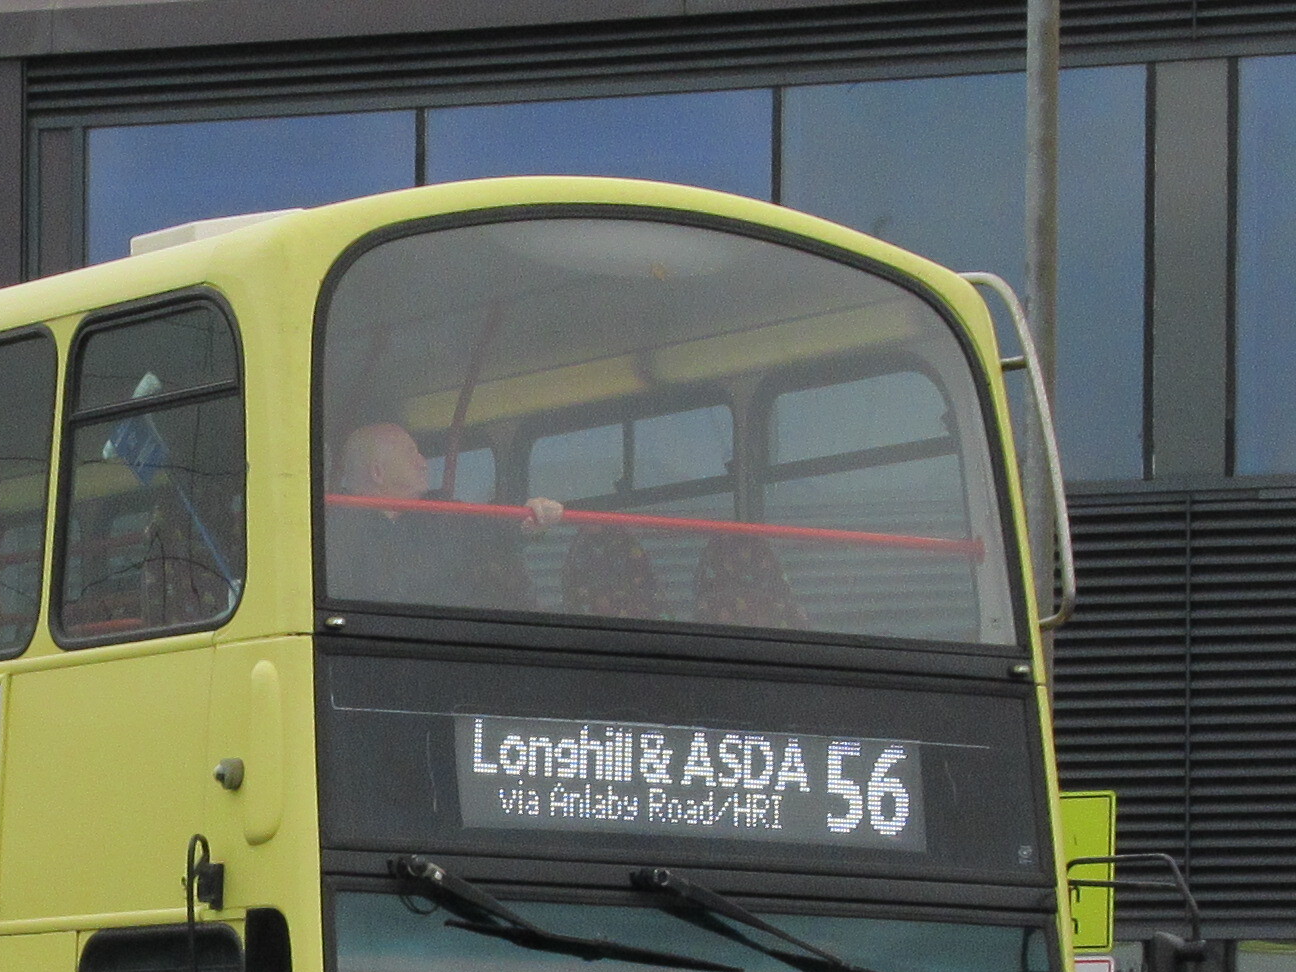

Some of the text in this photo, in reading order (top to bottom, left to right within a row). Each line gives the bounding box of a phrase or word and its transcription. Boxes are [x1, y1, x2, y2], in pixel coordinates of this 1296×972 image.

[472, 717, 911, 837] Longhill & ASDA 56
[498, 779, 783, 831] via Anlaby Road/HRI
